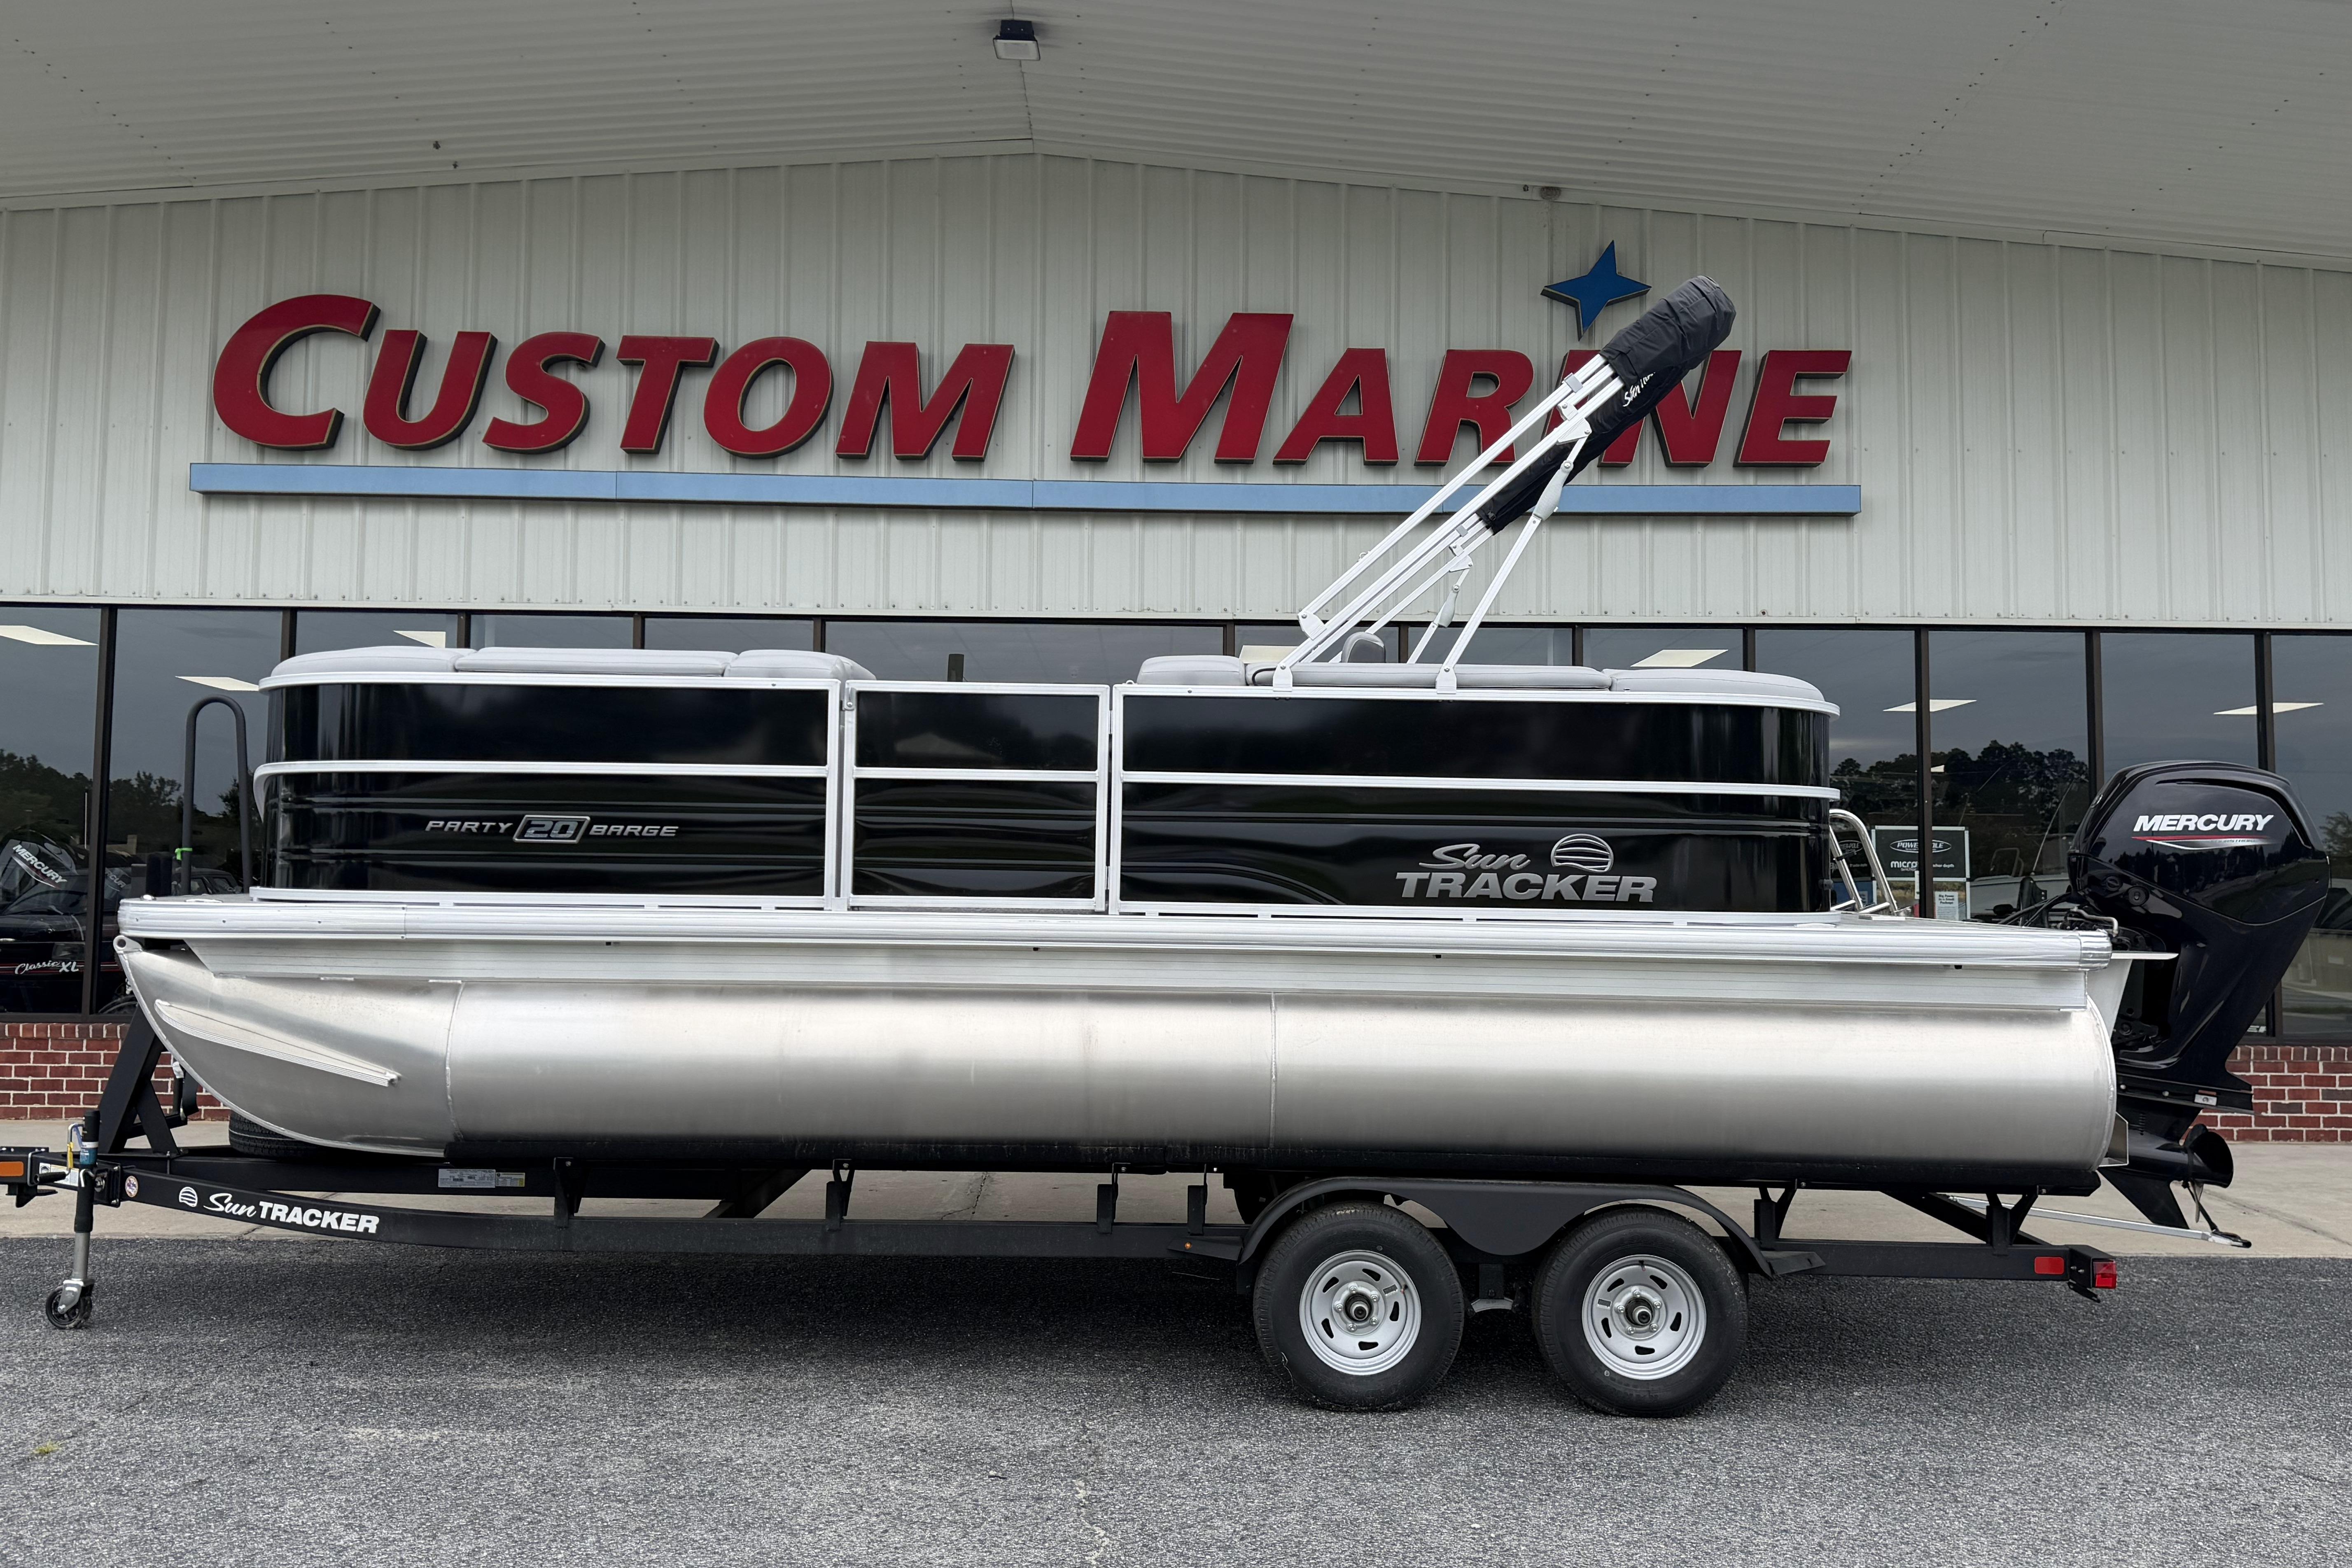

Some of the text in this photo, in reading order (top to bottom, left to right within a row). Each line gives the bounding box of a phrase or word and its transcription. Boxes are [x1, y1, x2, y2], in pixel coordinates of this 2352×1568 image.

[212, 294, 1015, 462] CUSTOM
[425, 821, 679, 838] PARTY 20 BARGE
[2133, 814, 2274, 831] MERCURY
[13, 845, 68, 883] MERCURY
[1419, 843, 1531, 870] Sun
[1396, 872, 1657, 902] TRACKER
[14, 960, 79, 974] Classic XL
[203, 1193, 380, 1234] Sun TRACKER
